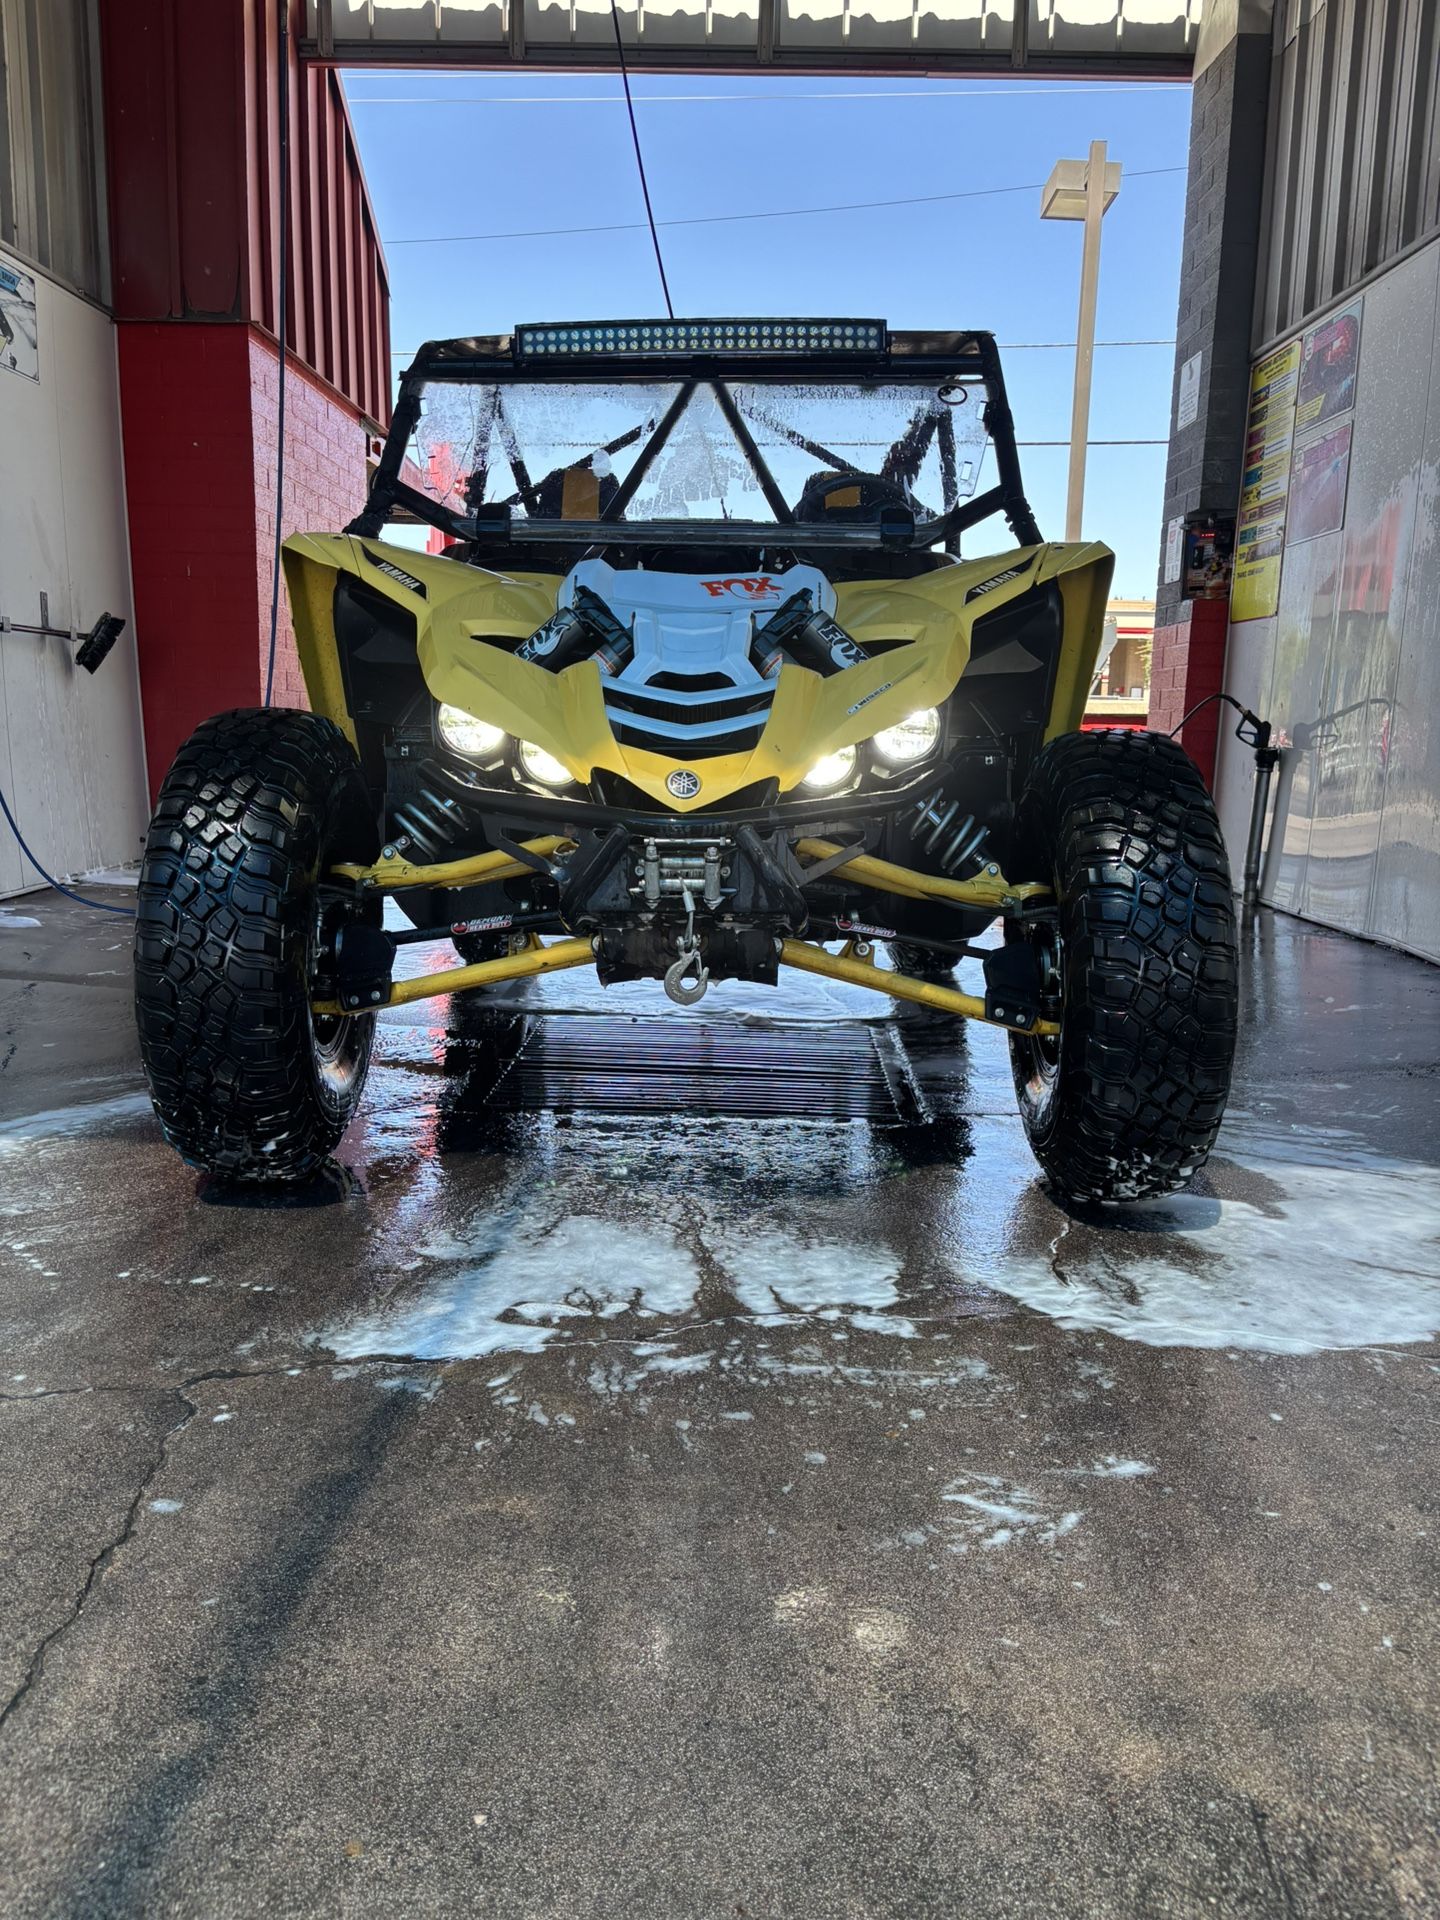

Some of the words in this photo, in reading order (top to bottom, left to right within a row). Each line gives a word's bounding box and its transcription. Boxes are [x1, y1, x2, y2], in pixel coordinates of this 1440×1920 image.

[377, 562, 421, 589] YAMAHA
[972, 571, 1022, 594] YAMAHA
[700, 577, 783, 600] FOX
[818, 624, 868, 669] FOX
[469, 923, 491, 931] HEAVY
[491, 921, 508, 929] DUTY
[853, 925, 875, 933] HEAVY
[875, 928, 892, 936] DUTY
